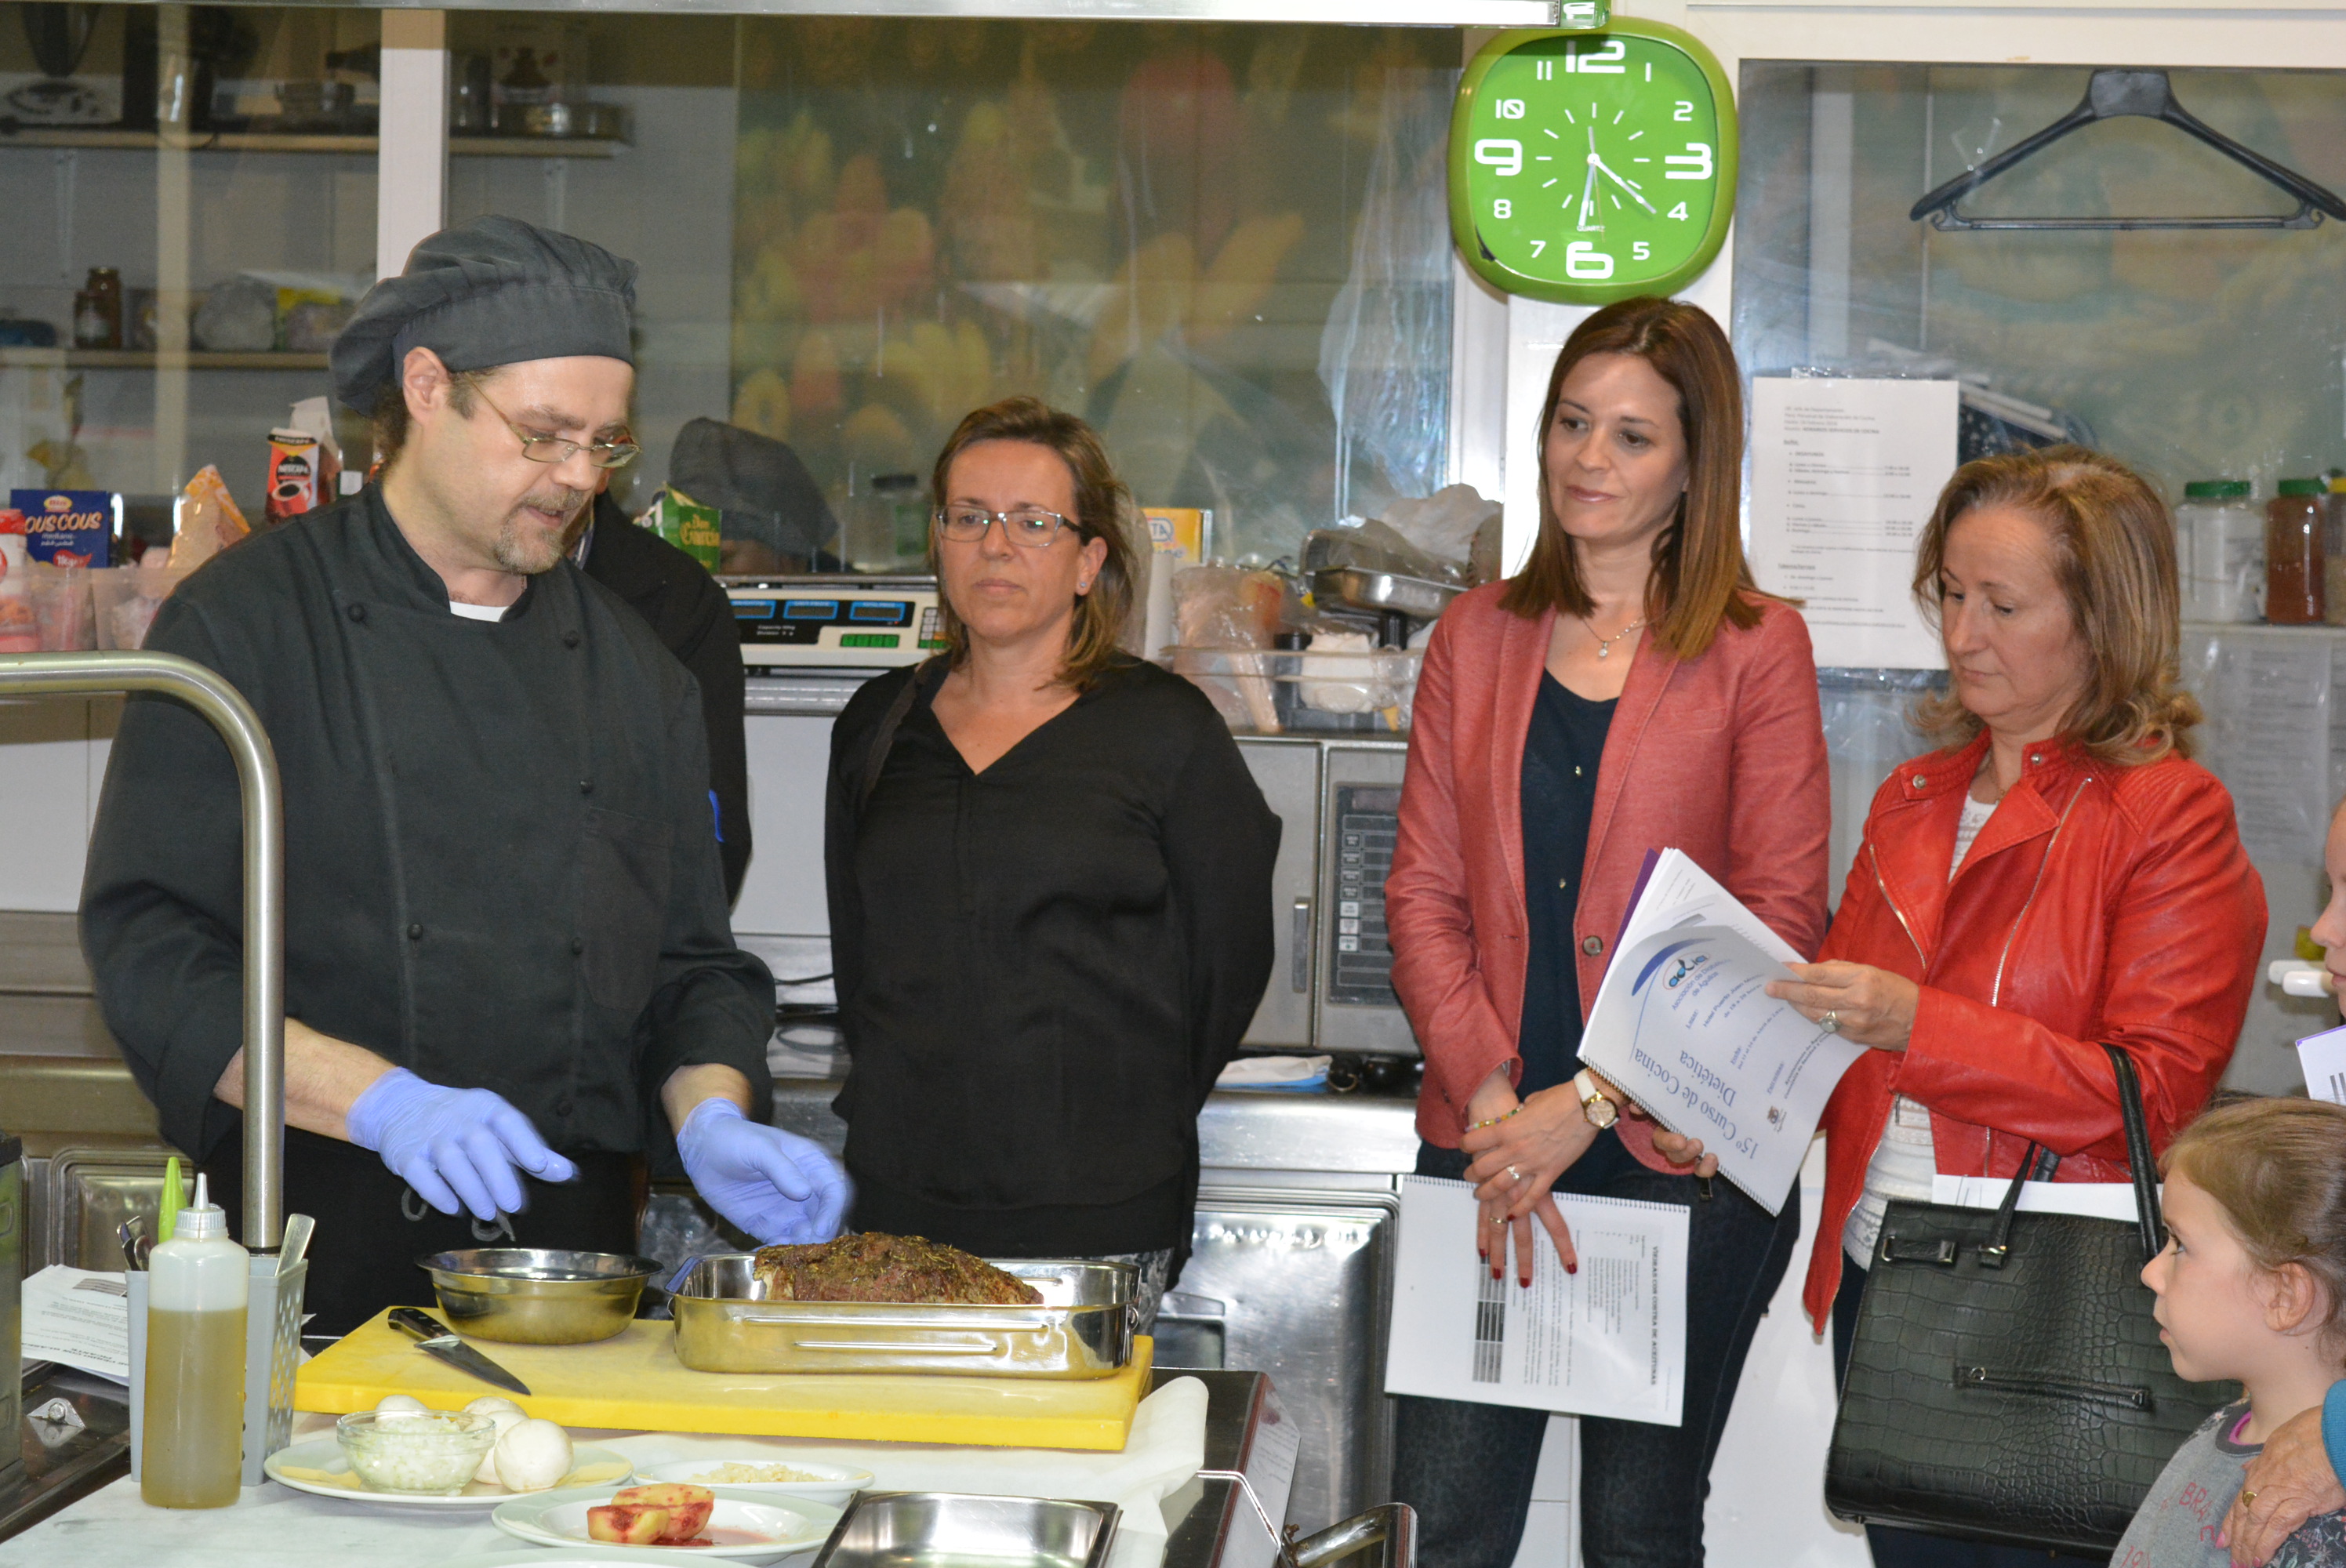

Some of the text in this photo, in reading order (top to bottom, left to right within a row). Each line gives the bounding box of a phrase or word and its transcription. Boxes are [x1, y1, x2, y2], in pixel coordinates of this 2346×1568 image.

[1566, 41, 1625, 73] 12
[1537, 60, 1552, 80] 11
[1495, 99, 1524, 118] 10
[1673, 100, 1694, 121] 2
[1474, 139, 1522, 176] 9
[1665, 143, 1712, 179] 3
[1494, 199, 1512, 219] 8
[1667, 201, 1688, 220] 4
[1530, 240, 1546, 258] 7
[1566, 241, 1614, 279] 6
[1632, 241, 1650, 260] 5
[24, 511, 103, 534] OUSCOUS
[1680, 1050, 1737, 1108] Dietética
[1634, 1048, 1759, 1160] 15º Curso de Cocina
